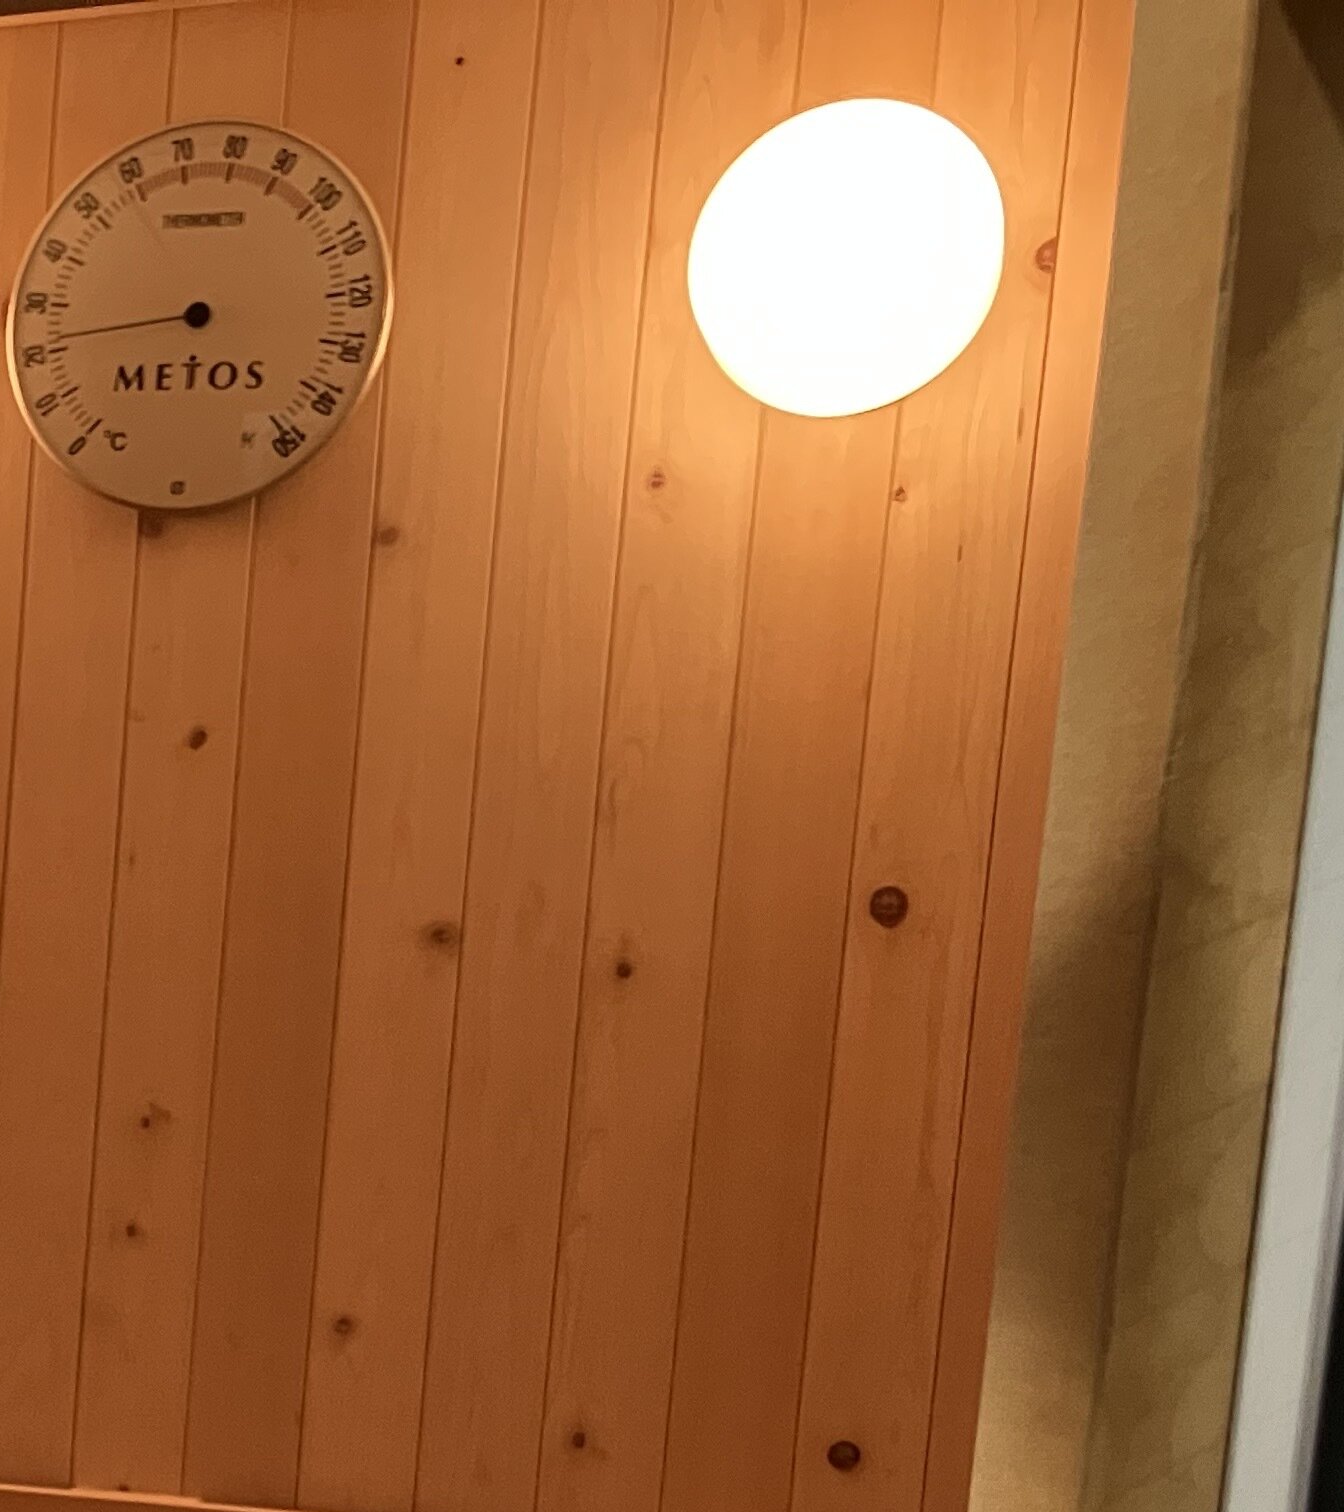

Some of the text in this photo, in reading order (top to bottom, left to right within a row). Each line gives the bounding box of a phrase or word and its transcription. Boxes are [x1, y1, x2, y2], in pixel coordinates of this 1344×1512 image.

[171, 137, 195, 162] 70
[222, 134, 249, 159] 80
[271, 148, 298, 175] 90
[73, 191, 100, 220] 50
[308, 176, 343, 212] 100
[42, 238, 68, 264] 40
[336, 219, 367, 257] 110
[25, 292, 48, 315] 30
[346, 273, 373, 309] 120
[22, 345, 46, 368] 20
[336, 331, 367, 364] 130
[112, 354, 264, 392] METOS
[35, 392, 60, 416] 10
[310, 383, 344, 416] 140
[68, 436, 87, 456] 0
[271, 424, 307, 458] 150
